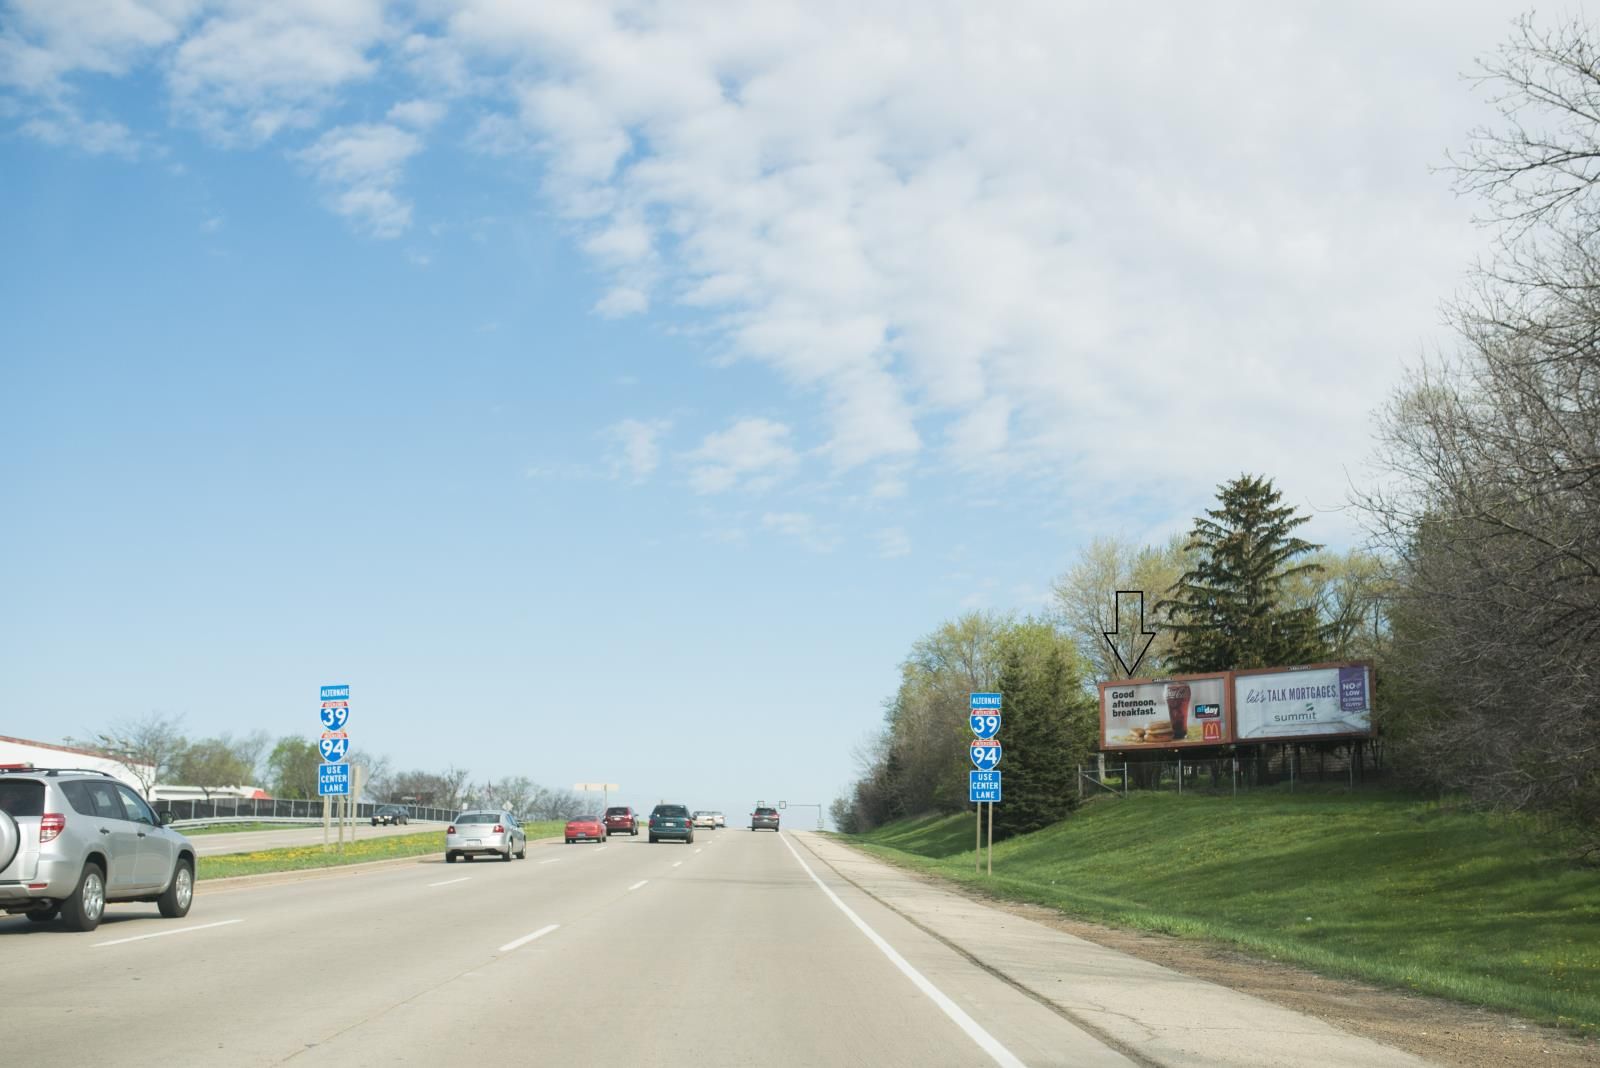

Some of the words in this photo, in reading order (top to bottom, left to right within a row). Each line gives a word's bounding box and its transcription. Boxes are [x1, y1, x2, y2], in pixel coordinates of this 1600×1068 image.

[321, 689, 349, 697] ALTERNATE
[1112, 690, 1134, 699] Good
[1246, 688, 1266, 704] let's
[1267, 688, 1287, 702] TALK
[972, 697, 1000, 705] ALTERNATE
[1112, 699, 1157, 709] afternoon.
[322, 708, 346, 726] 39
[1112, 707, 1156, 717] breakfast.
[1274, 712, 1317, 722] summit
[973, 716, 998, 733] 39
[321, 740, 345, 757] 94
[973, 747, 997, 764] 94
[326, 765, 342, 774] USE
[320, 774, 347, 783] CENTER
[978, 773, 993, 781] USE
[324, 783, 344, 793] LANE
[972, 781, 999, 790] CENTER
[976, 791, 995, 799] LANE
